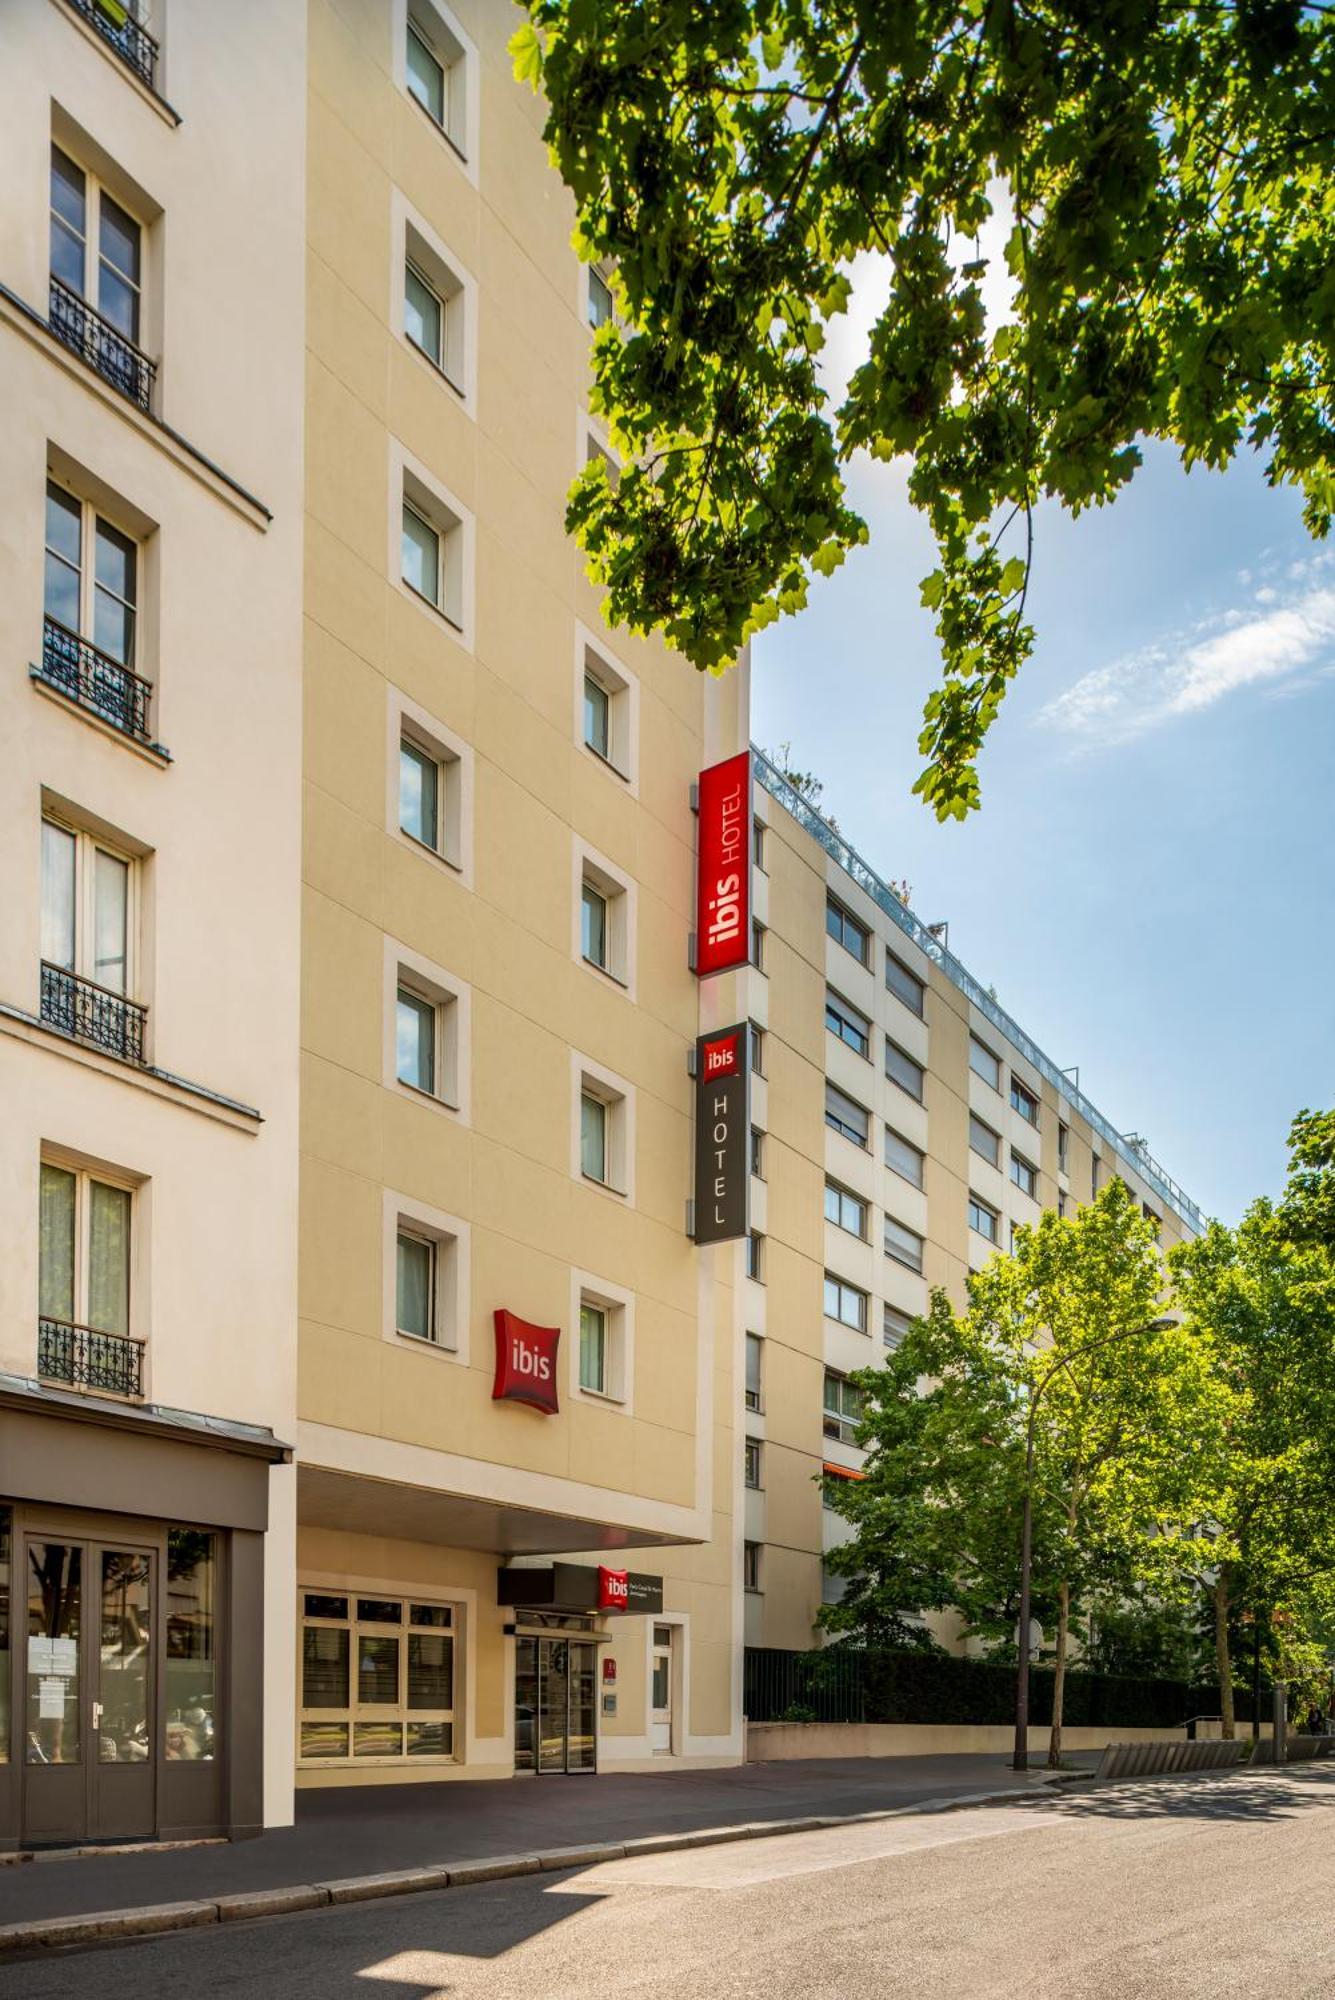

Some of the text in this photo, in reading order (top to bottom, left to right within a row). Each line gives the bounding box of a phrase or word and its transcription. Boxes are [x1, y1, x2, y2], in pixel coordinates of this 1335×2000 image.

[708, 783, 741, 945] ibis HOTEL
[708, 1050, 734, 1070] ibis
[713, 1095, 728, 1224] HOTEL
[512, 1338, 550, 1380] ibis
[608, 1576, 628, 1597] ibis
